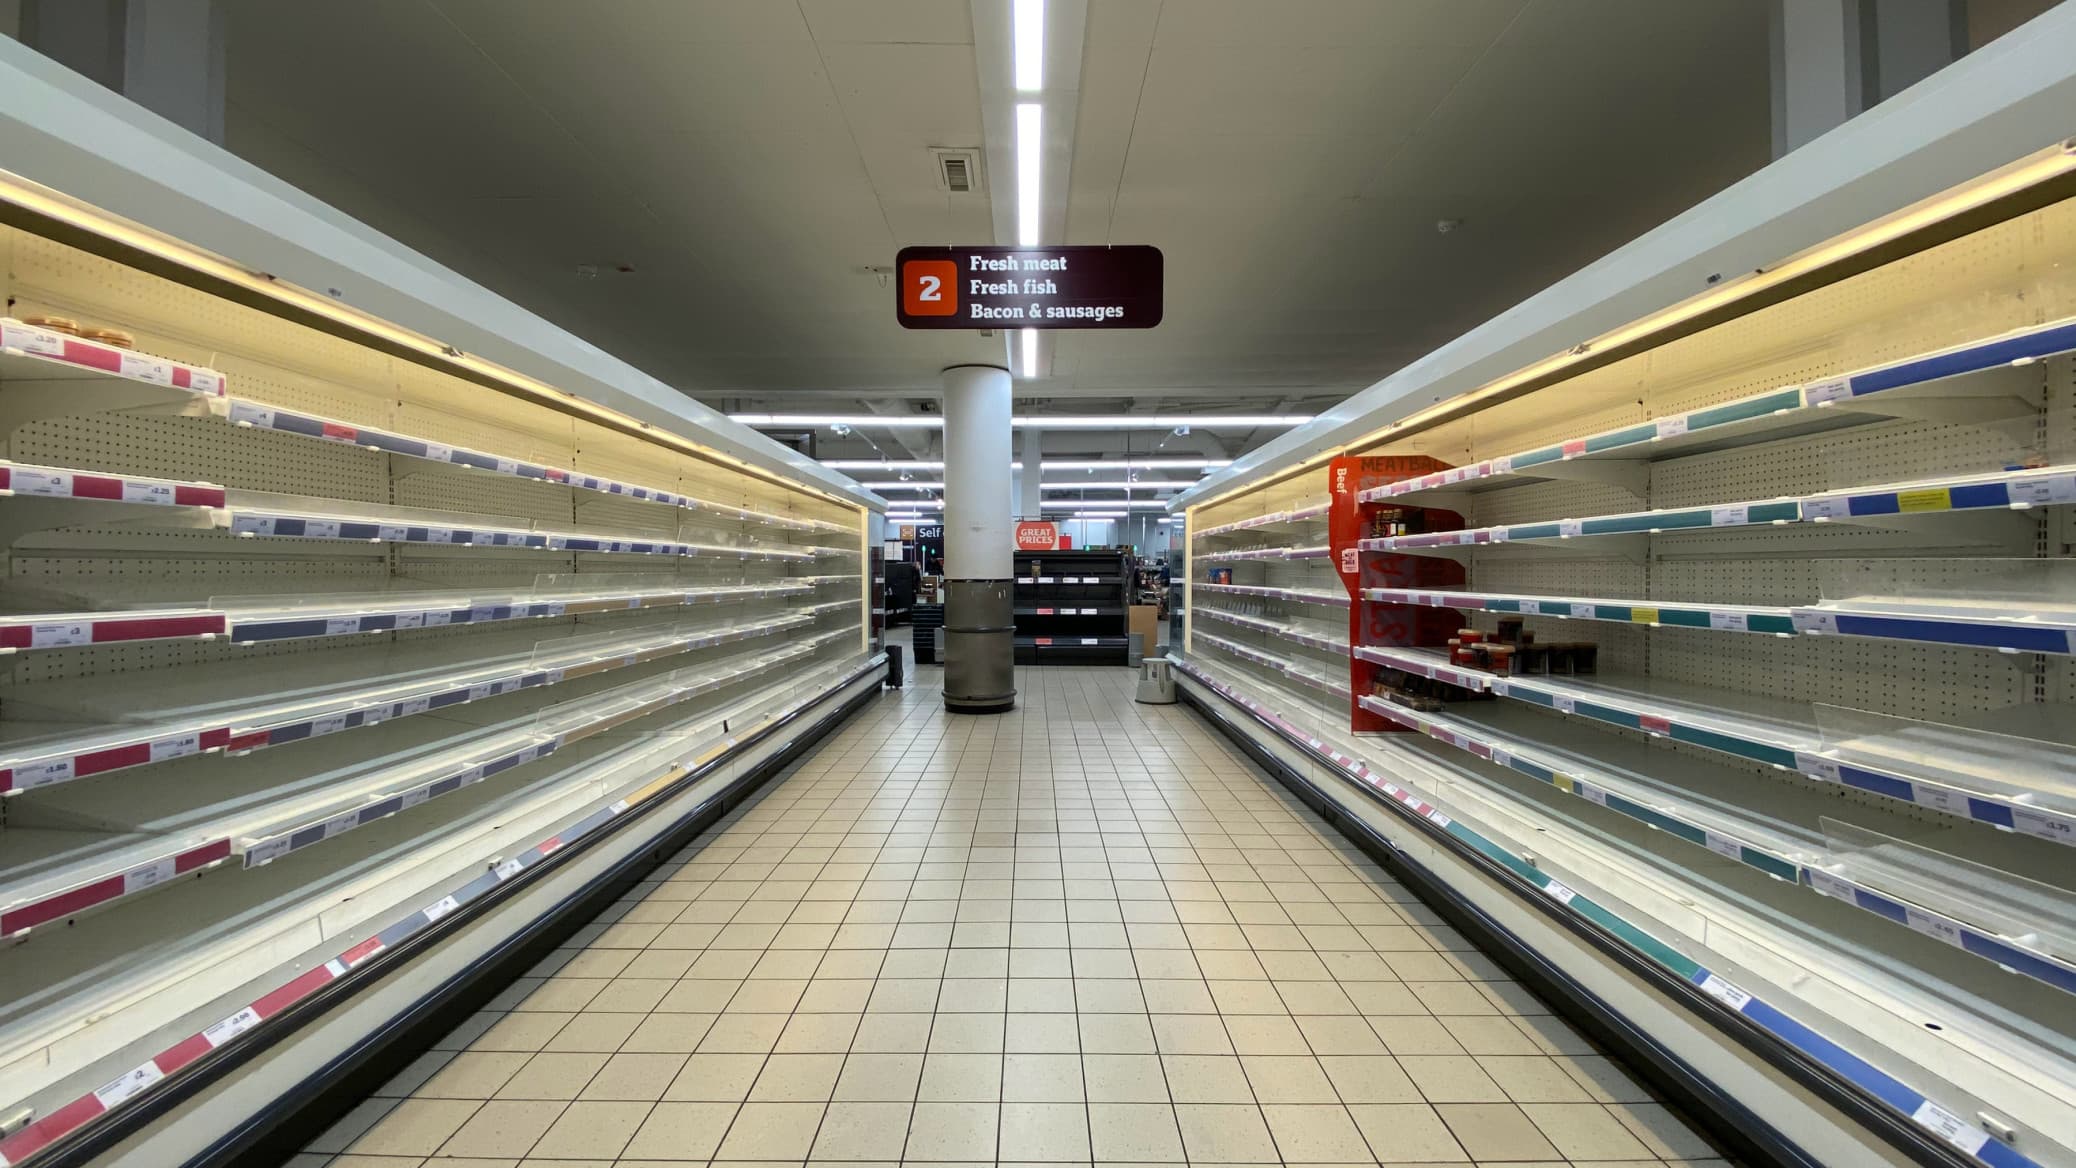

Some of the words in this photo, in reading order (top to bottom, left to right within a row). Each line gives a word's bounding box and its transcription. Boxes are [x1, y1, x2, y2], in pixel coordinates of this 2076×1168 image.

[970, 256, 1019, 271] Fresh
[1023, 256, 1067, 271] meat
[919, 275, 941, 301] 2
[970, 279, 1018, 294] Fresh
[1023, 279, 1057, 294] fish
[970, 303, 1024, 318] Bacon
[1029, 303, 1042, 318] &
[1046, 305, 1124, 322] sausages
[1336, 468, 1347, 494] Beef
[919, 527, 941, 538] Self
[1020, 528, 1051, 537] GREAT
[1019, 536, 1053, 545] PRICES
